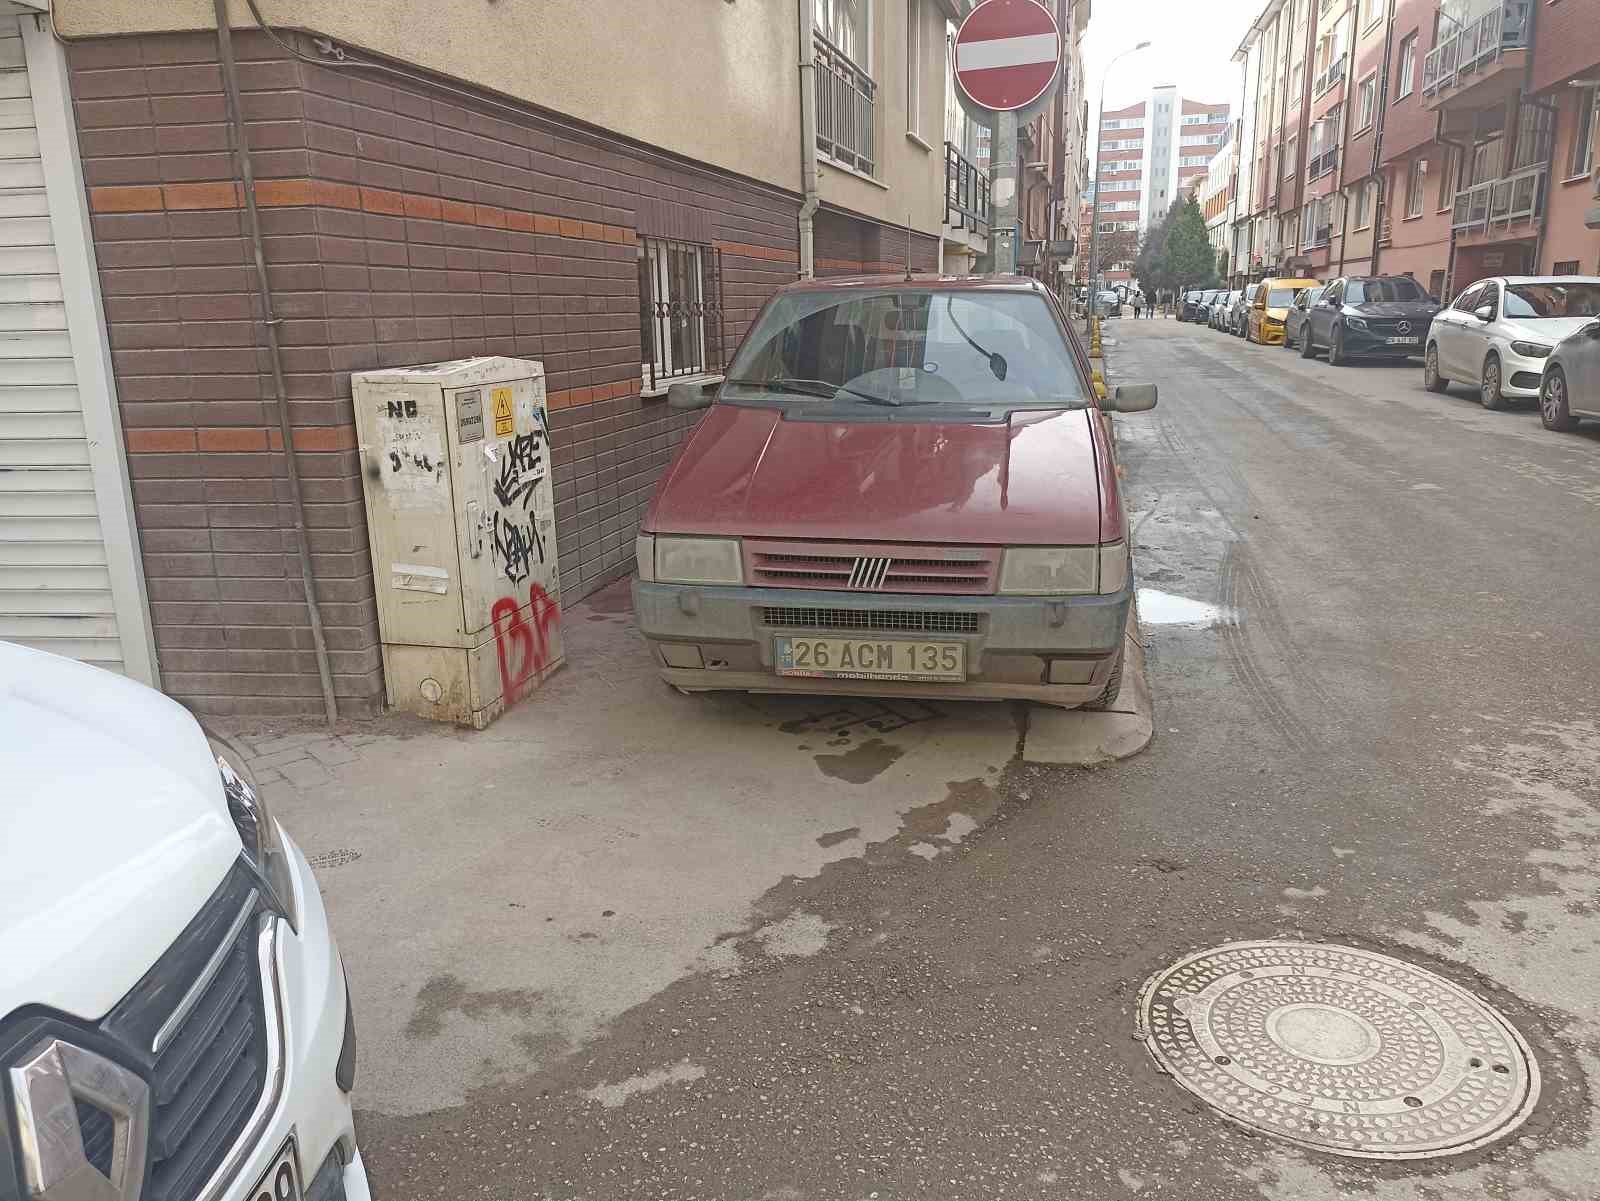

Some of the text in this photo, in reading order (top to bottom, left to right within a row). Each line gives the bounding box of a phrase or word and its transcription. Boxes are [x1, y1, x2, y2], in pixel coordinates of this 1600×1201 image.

[795, 641, 958, 671] 26 ACM 135
